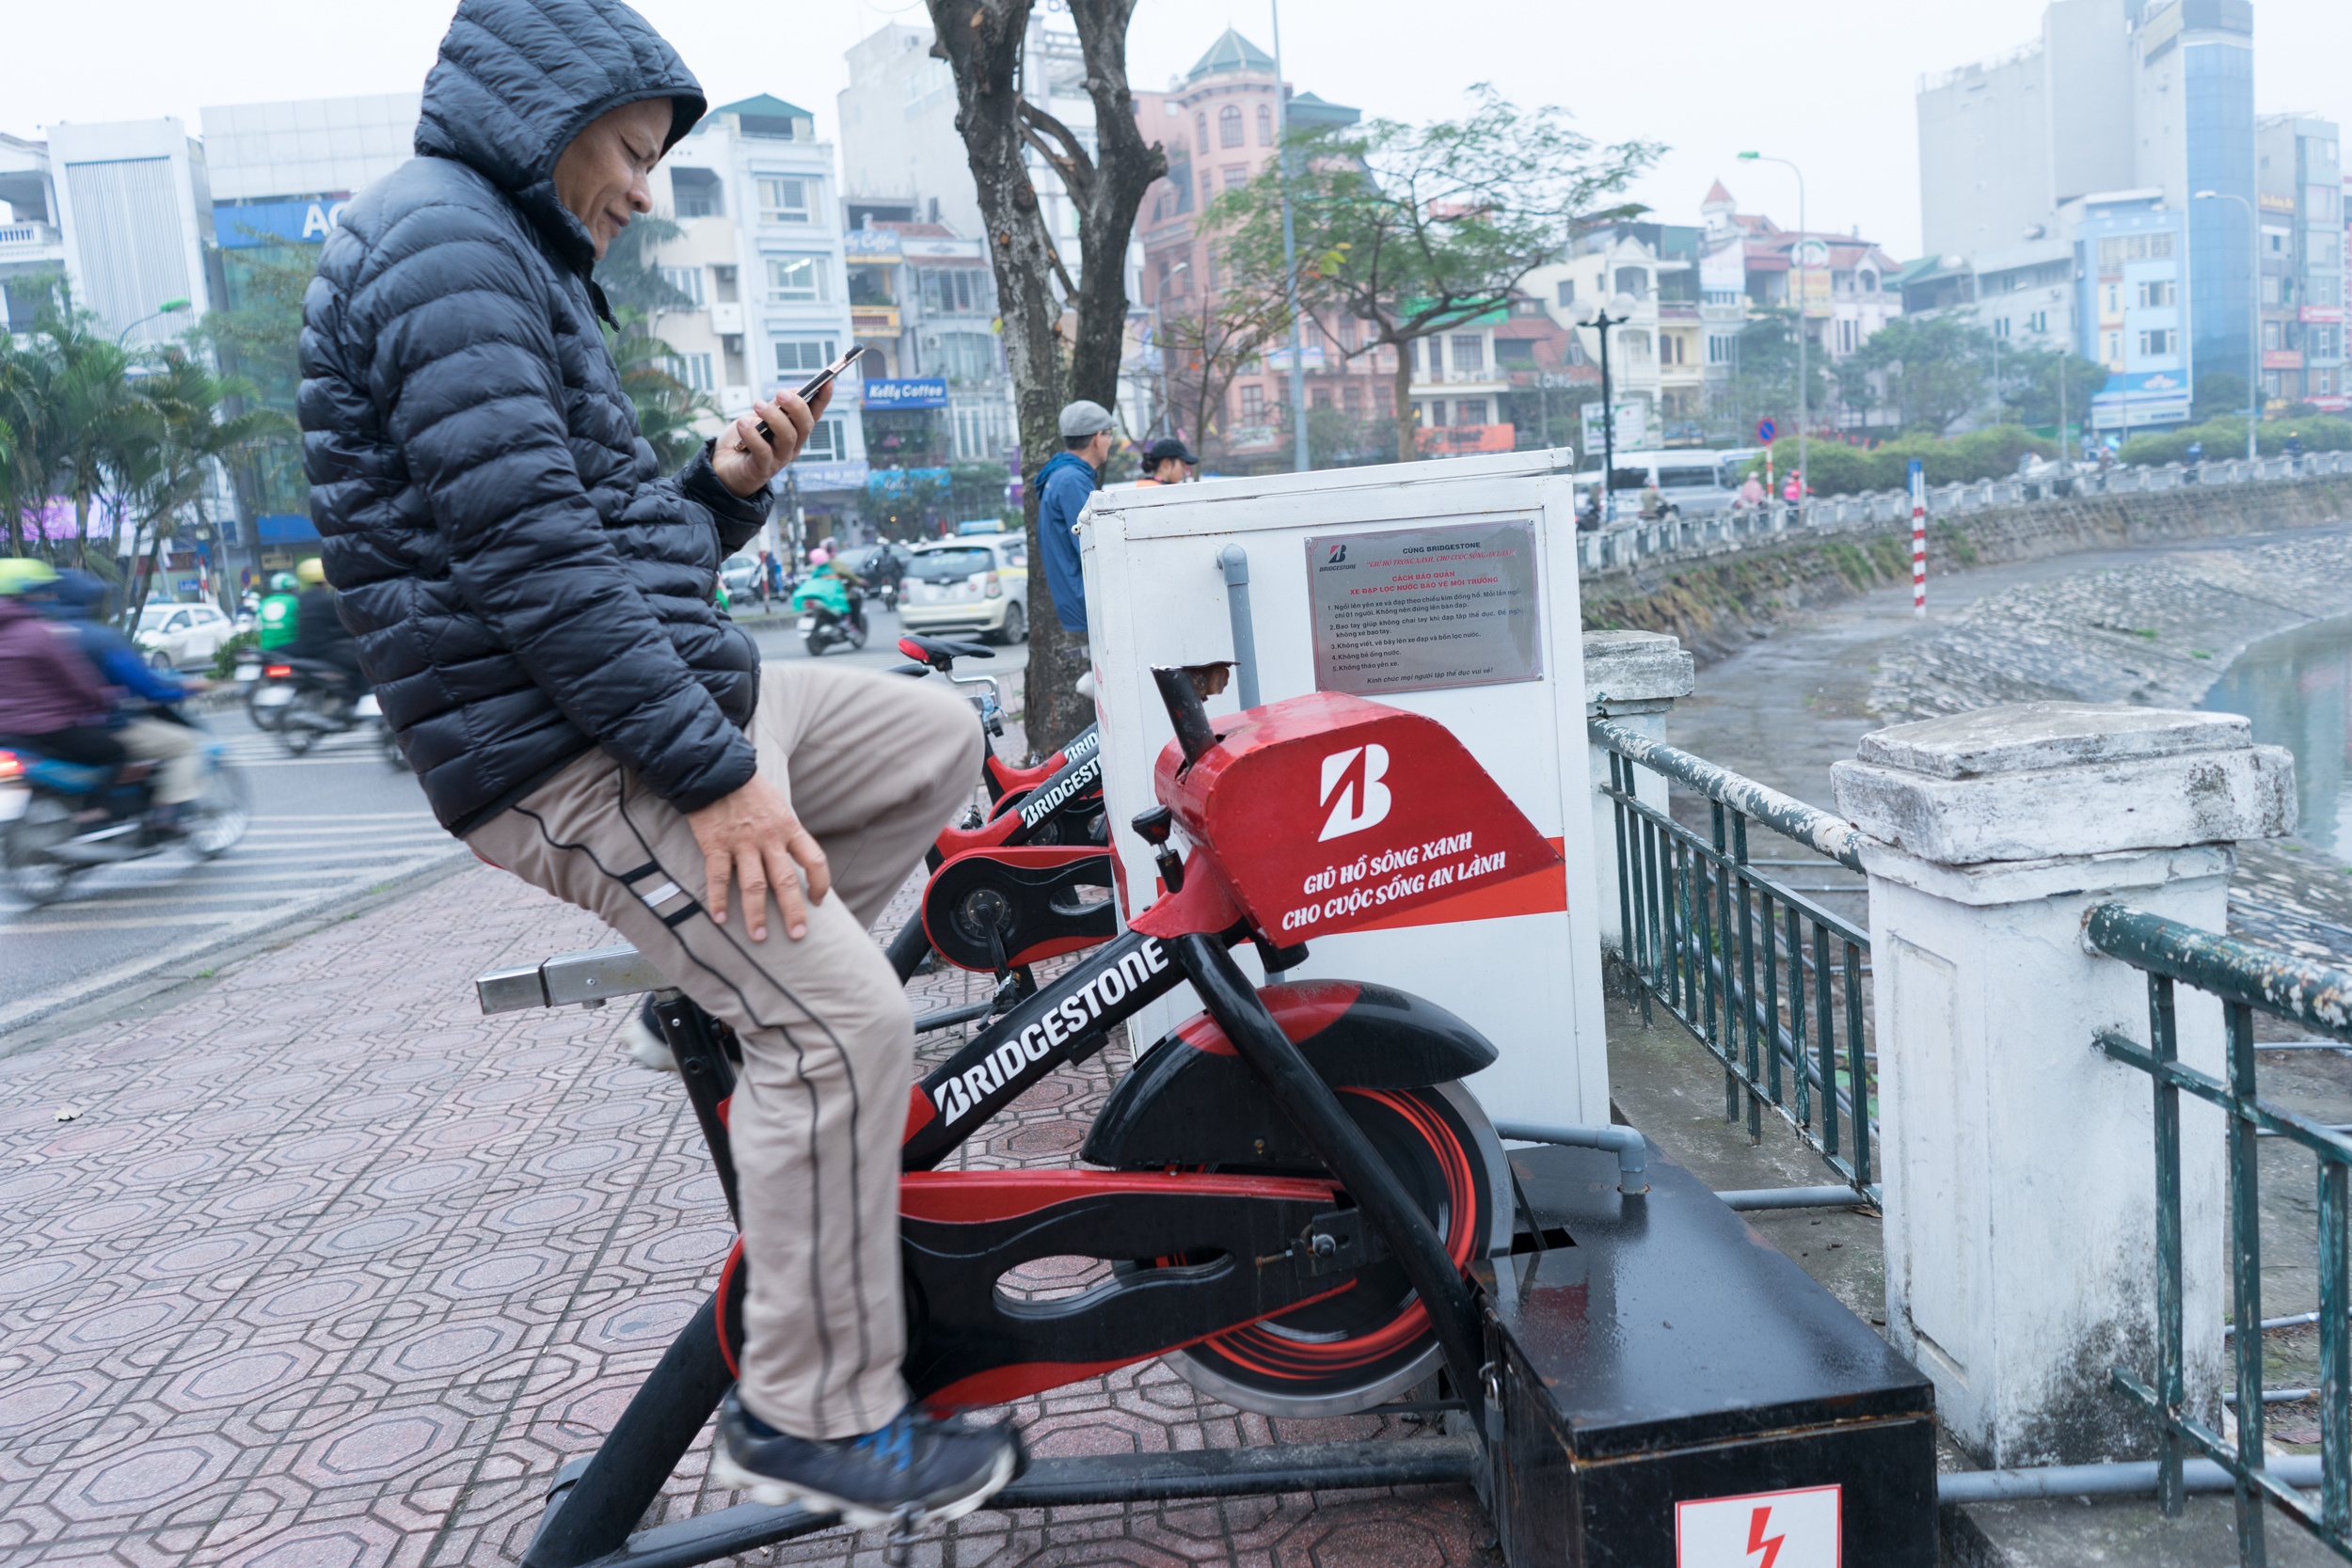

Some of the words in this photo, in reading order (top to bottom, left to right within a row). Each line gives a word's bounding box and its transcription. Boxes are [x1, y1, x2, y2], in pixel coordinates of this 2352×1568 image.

[868, 384, 901, 401] Kelly
[901, 384, 944, 398] Coffee
[1063, 729, 1099, 764] BRID
[1340, 853, 1368, 886] HỒ
[1370, 848, 1420, 877] SÔNG
[1421, 831, 1473, 863] XANH
[1281, 904, 1321, 931] CHO
[1324, 888, 1374, 916] CUỘC
[1375, 874, 1425, 905] SỐNG
[1427, 864, 1455, 889] AN
[1456, 850, 1507, 881] LÀNH
[933, 936, 1168, 1127] BRIDGESTONE
